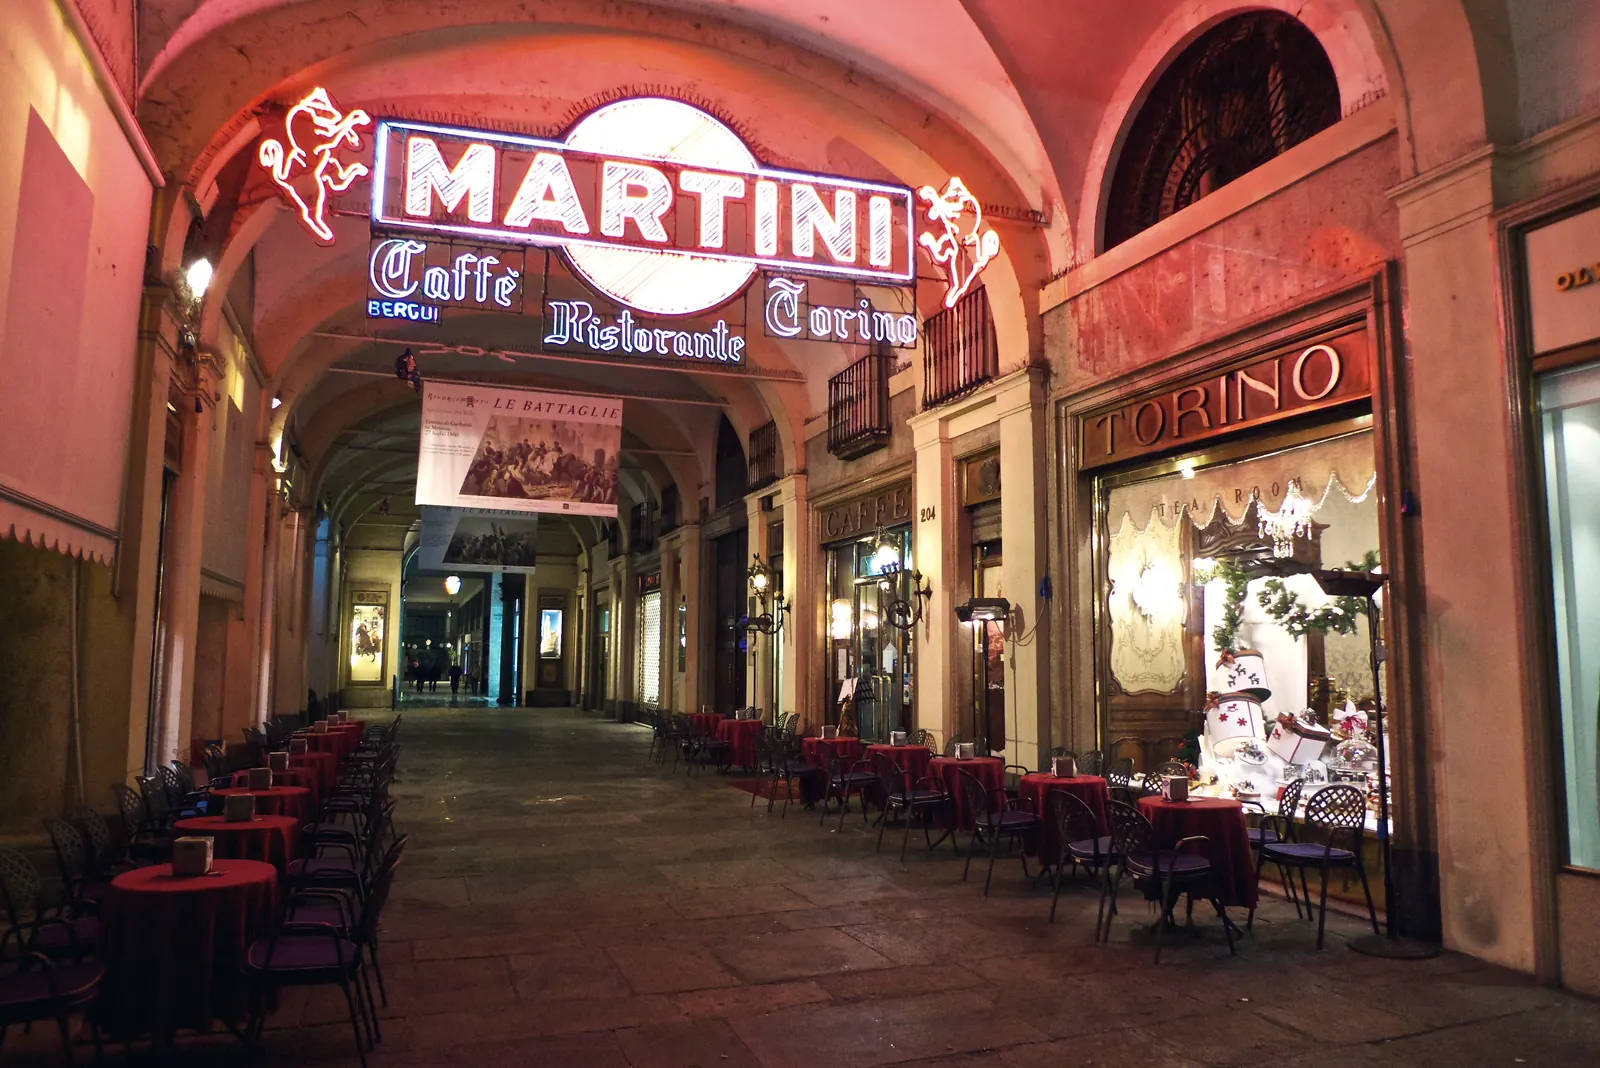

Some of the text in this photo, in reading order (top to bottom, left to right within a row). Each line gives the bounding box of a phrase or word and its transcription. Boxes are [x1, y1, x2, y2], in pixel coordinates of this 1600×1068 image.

[405, 136, 893, 269] MARTINI
[369, 238, 520, 308] Caffè
[543, 300, 746, 362] Ristorante
[764, 276, 918, 345] Torino
[493, 397, 621, 420] LE BATTAGLIE
[1096, 343, 1341, 456] TORINO
[920, 505, 936, 523] 204
[1159, 476, 1303, 517] TEA ROOM
